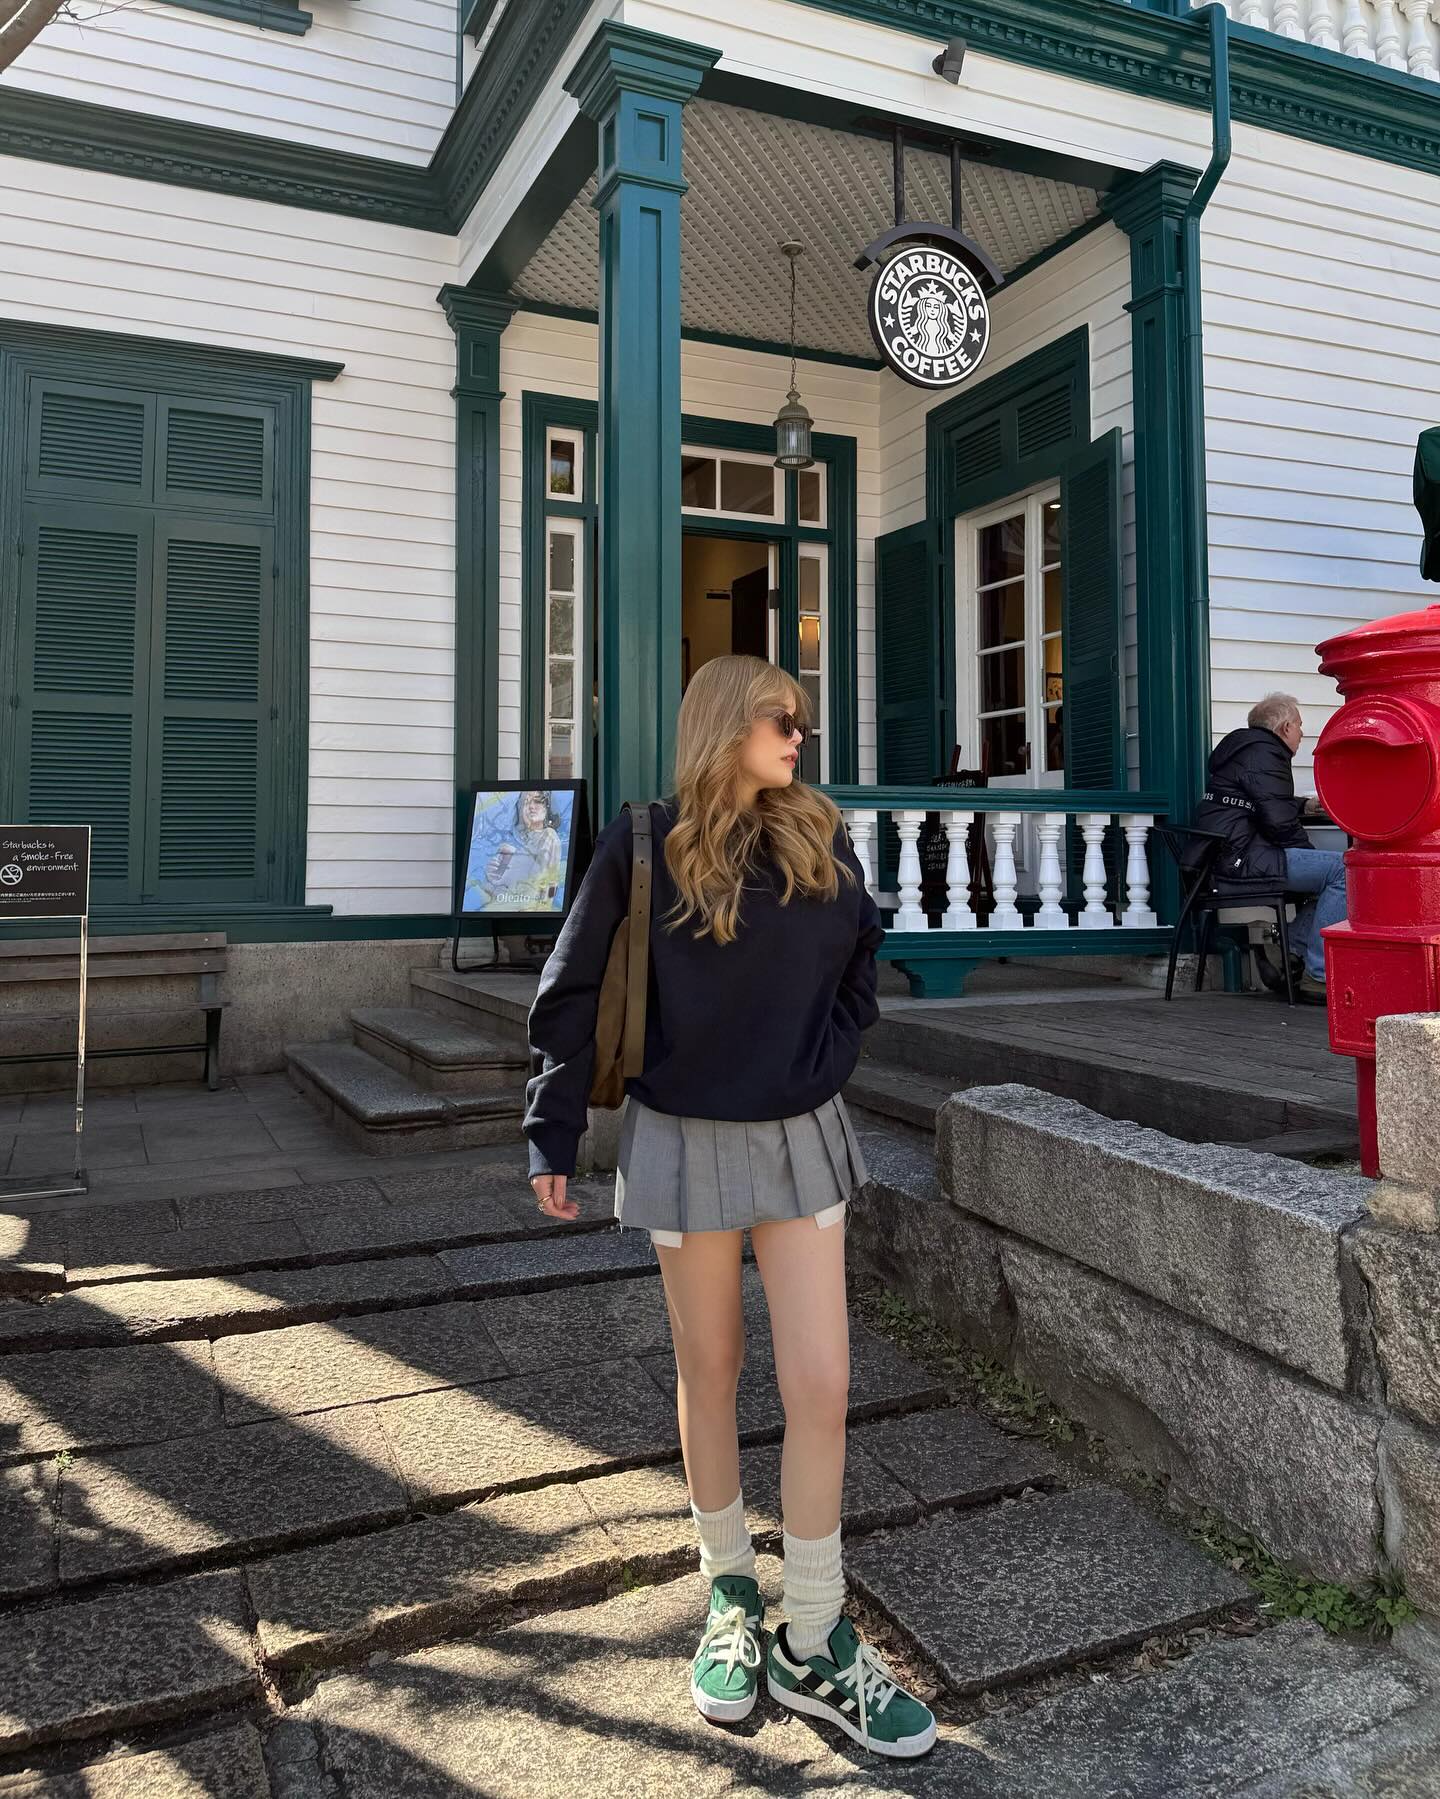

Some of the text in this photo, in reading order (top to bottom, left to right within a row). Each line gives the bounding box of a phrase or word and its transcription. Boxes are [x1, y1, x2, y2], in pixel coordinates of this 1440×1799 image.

[881, 254, 985, 321] STARBUCKS
[891, 336, 972, 378] COFFEE
[2, 840, 55, 849] Starbucks is
[496, 893, 531, 903] Oleato
